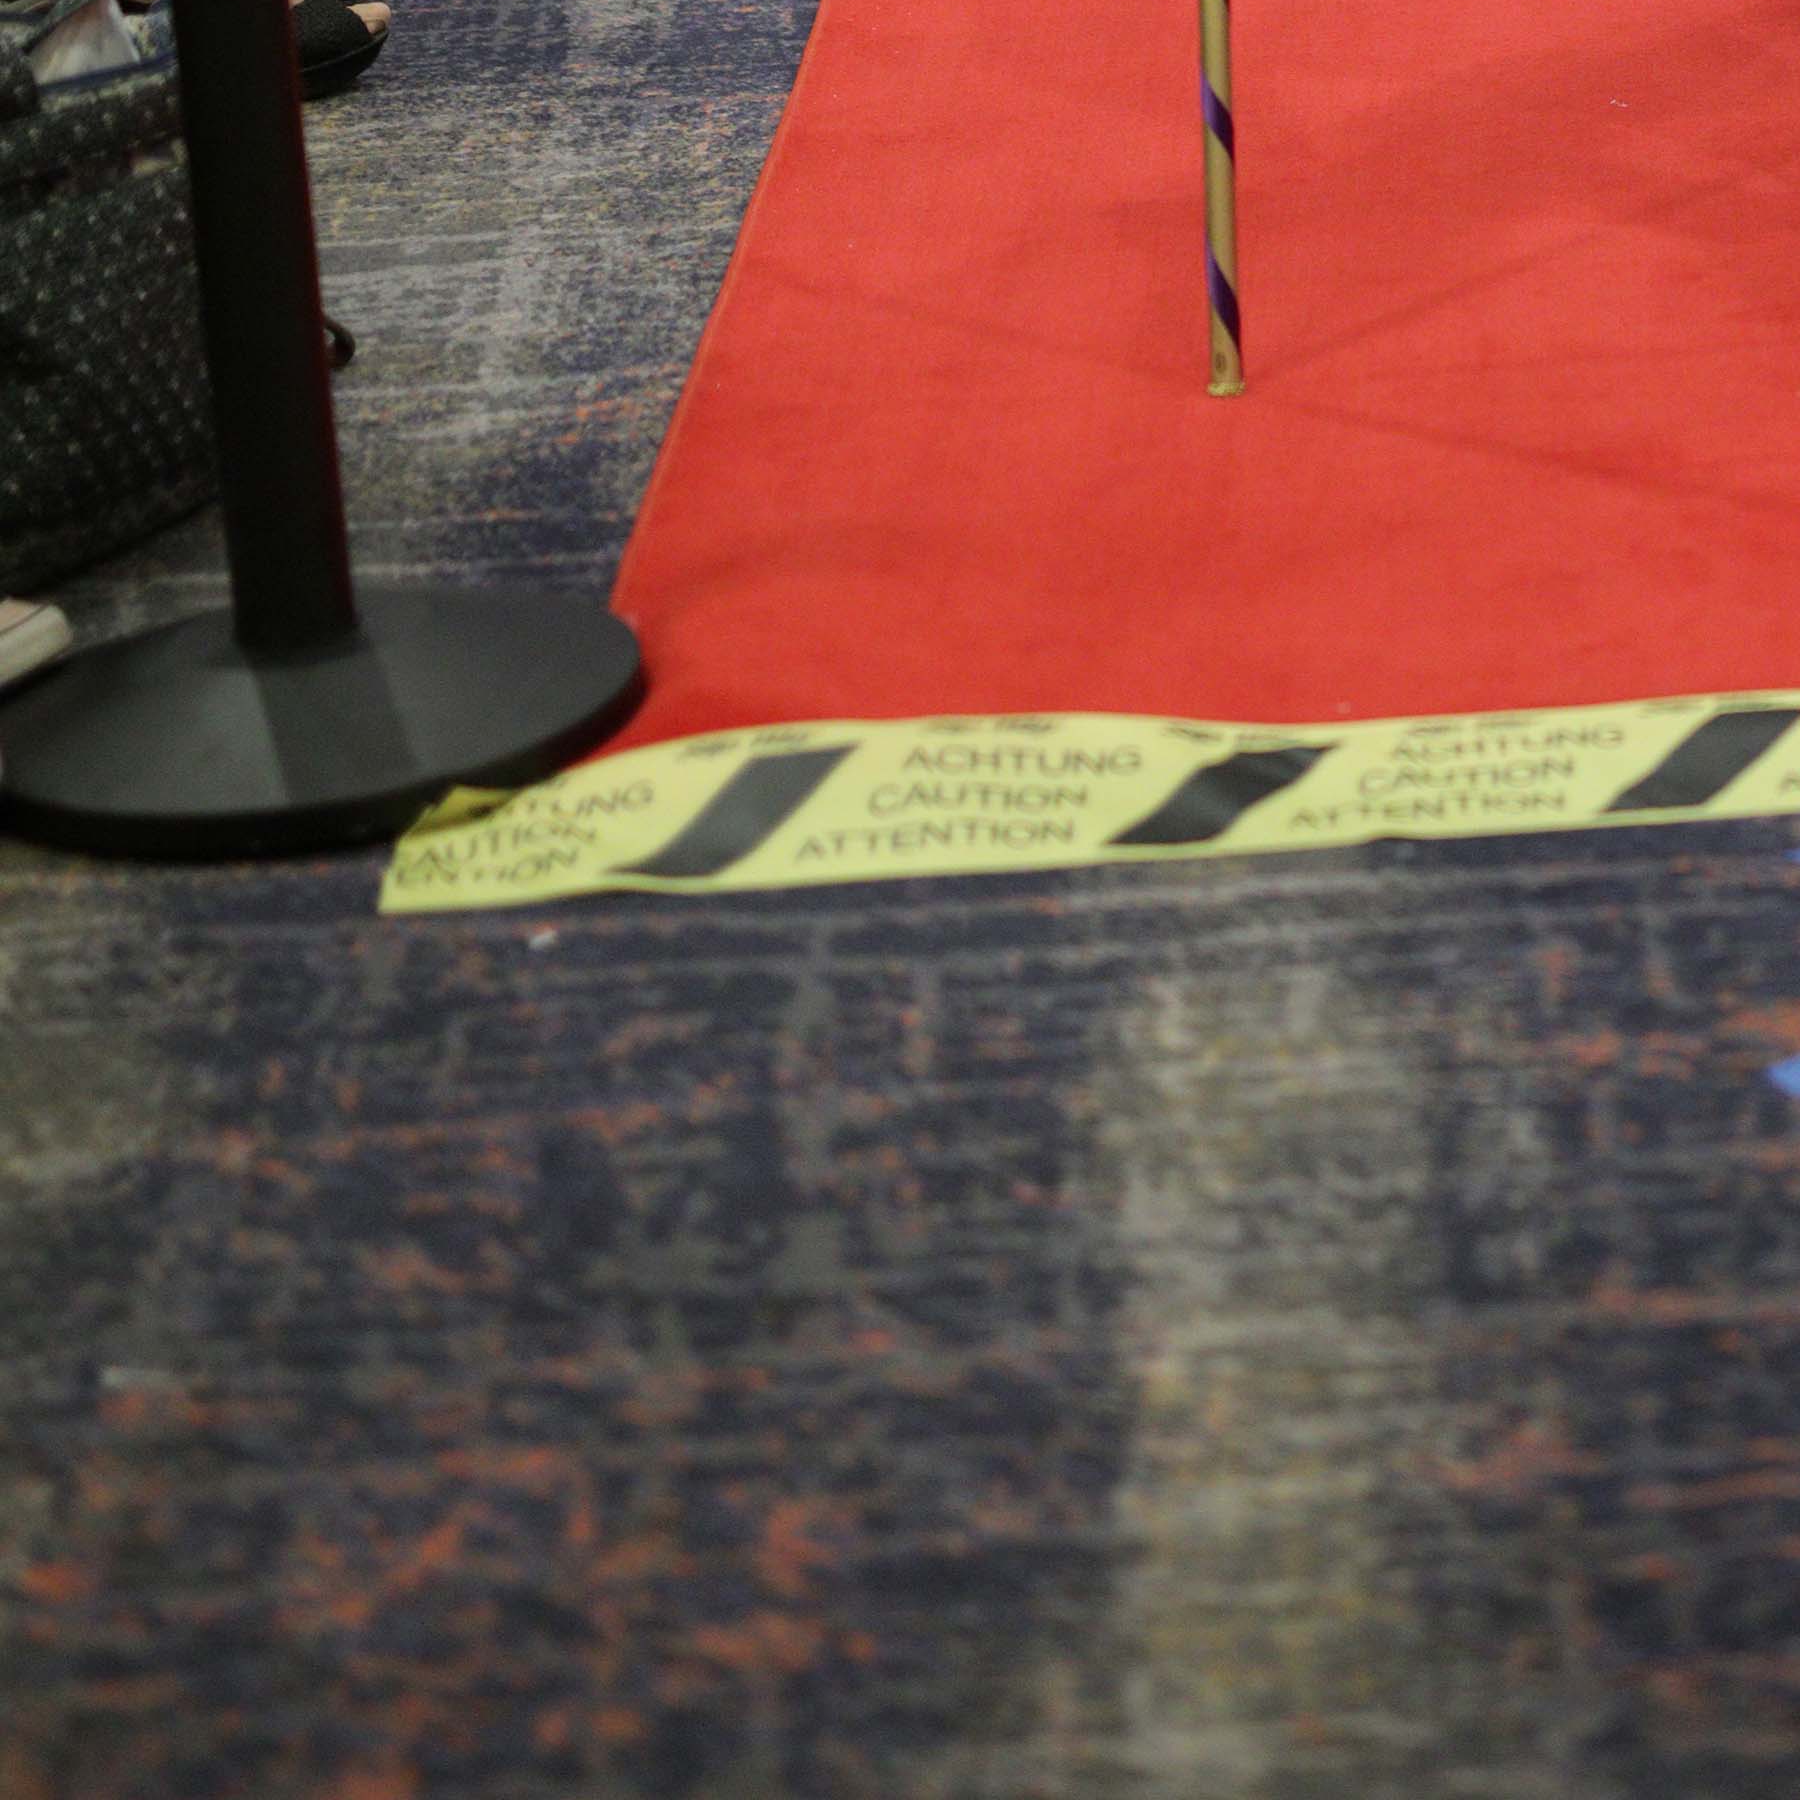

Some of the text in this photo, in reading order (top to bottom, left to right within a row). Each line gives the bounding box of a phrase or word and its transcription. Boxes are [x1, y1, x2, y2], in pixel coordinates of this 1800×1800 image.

[902, 743, 1144, 779] ACHTUNG
[1388, 721, 1627, 763] ACHTUNG
[1357, 752, 1576, 799] CAUTION
[866, 780, 1088, 818] CAUTION
[1286, 790, 1567, 832] ATTENTION
[793, 817, 1076, 864] ATTENTION
